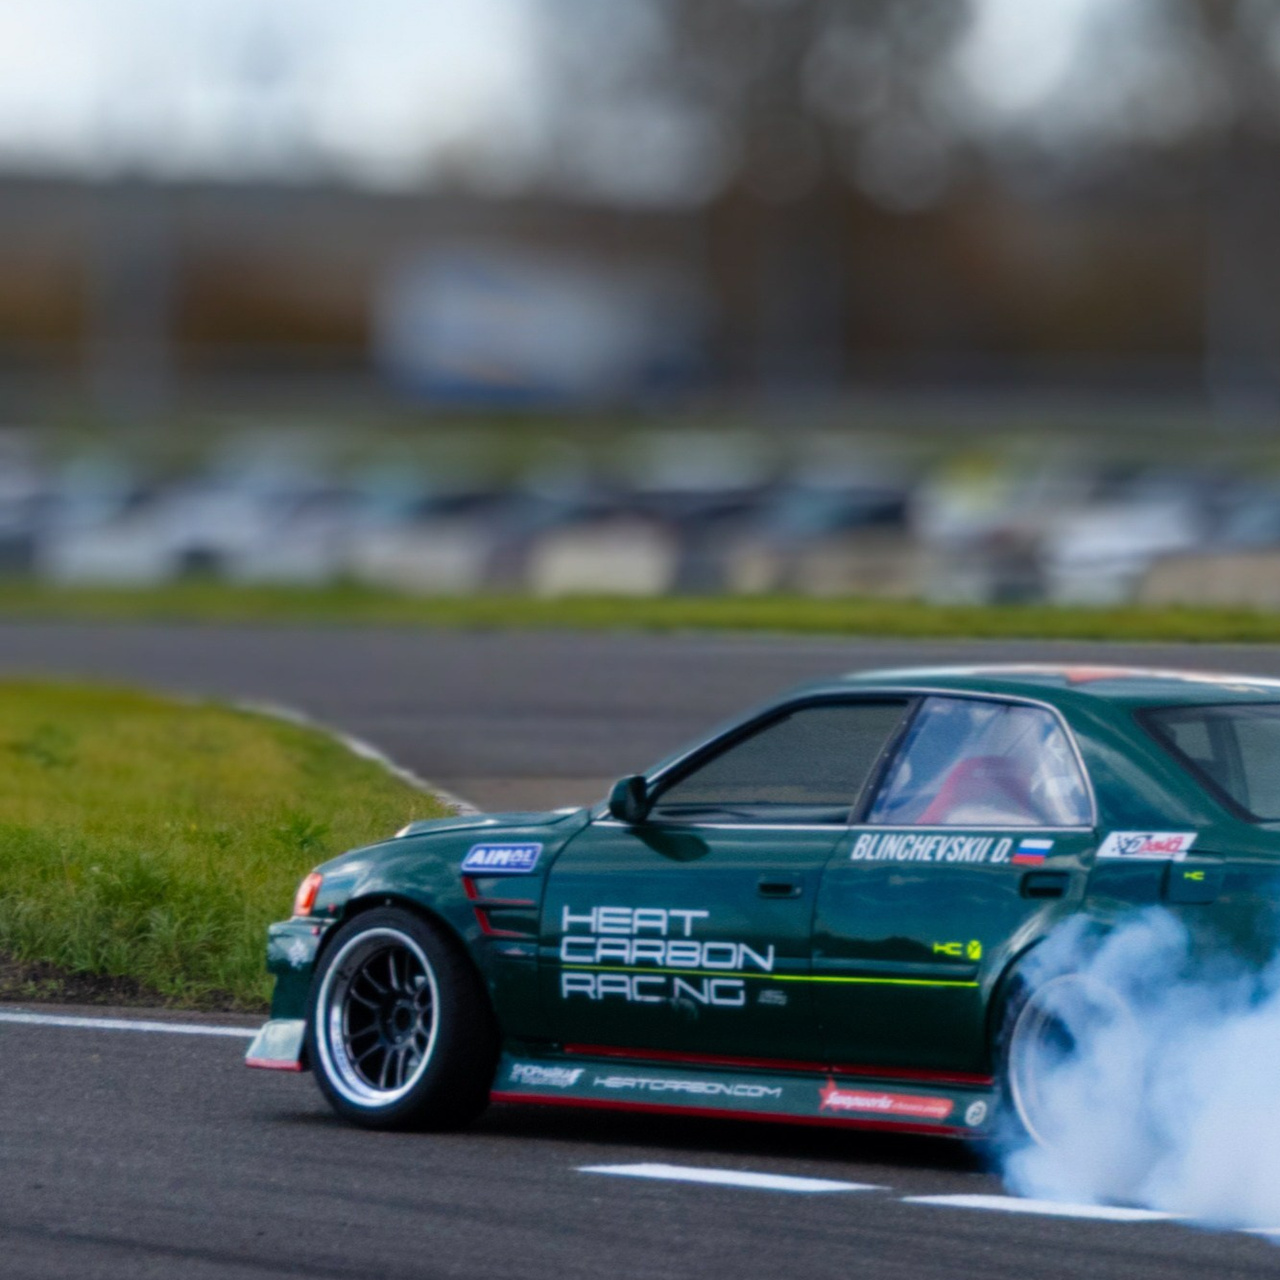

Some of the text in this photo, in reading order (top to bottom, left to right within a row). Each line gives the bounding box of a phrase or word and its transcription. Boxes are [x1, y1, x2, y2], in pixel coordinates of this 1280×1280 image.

[851, 833, 1013, 863] BLINCHEVSKII D.
[562, 905, 709, 937] HEAT
[560, 936, 774, 970] CARBON
